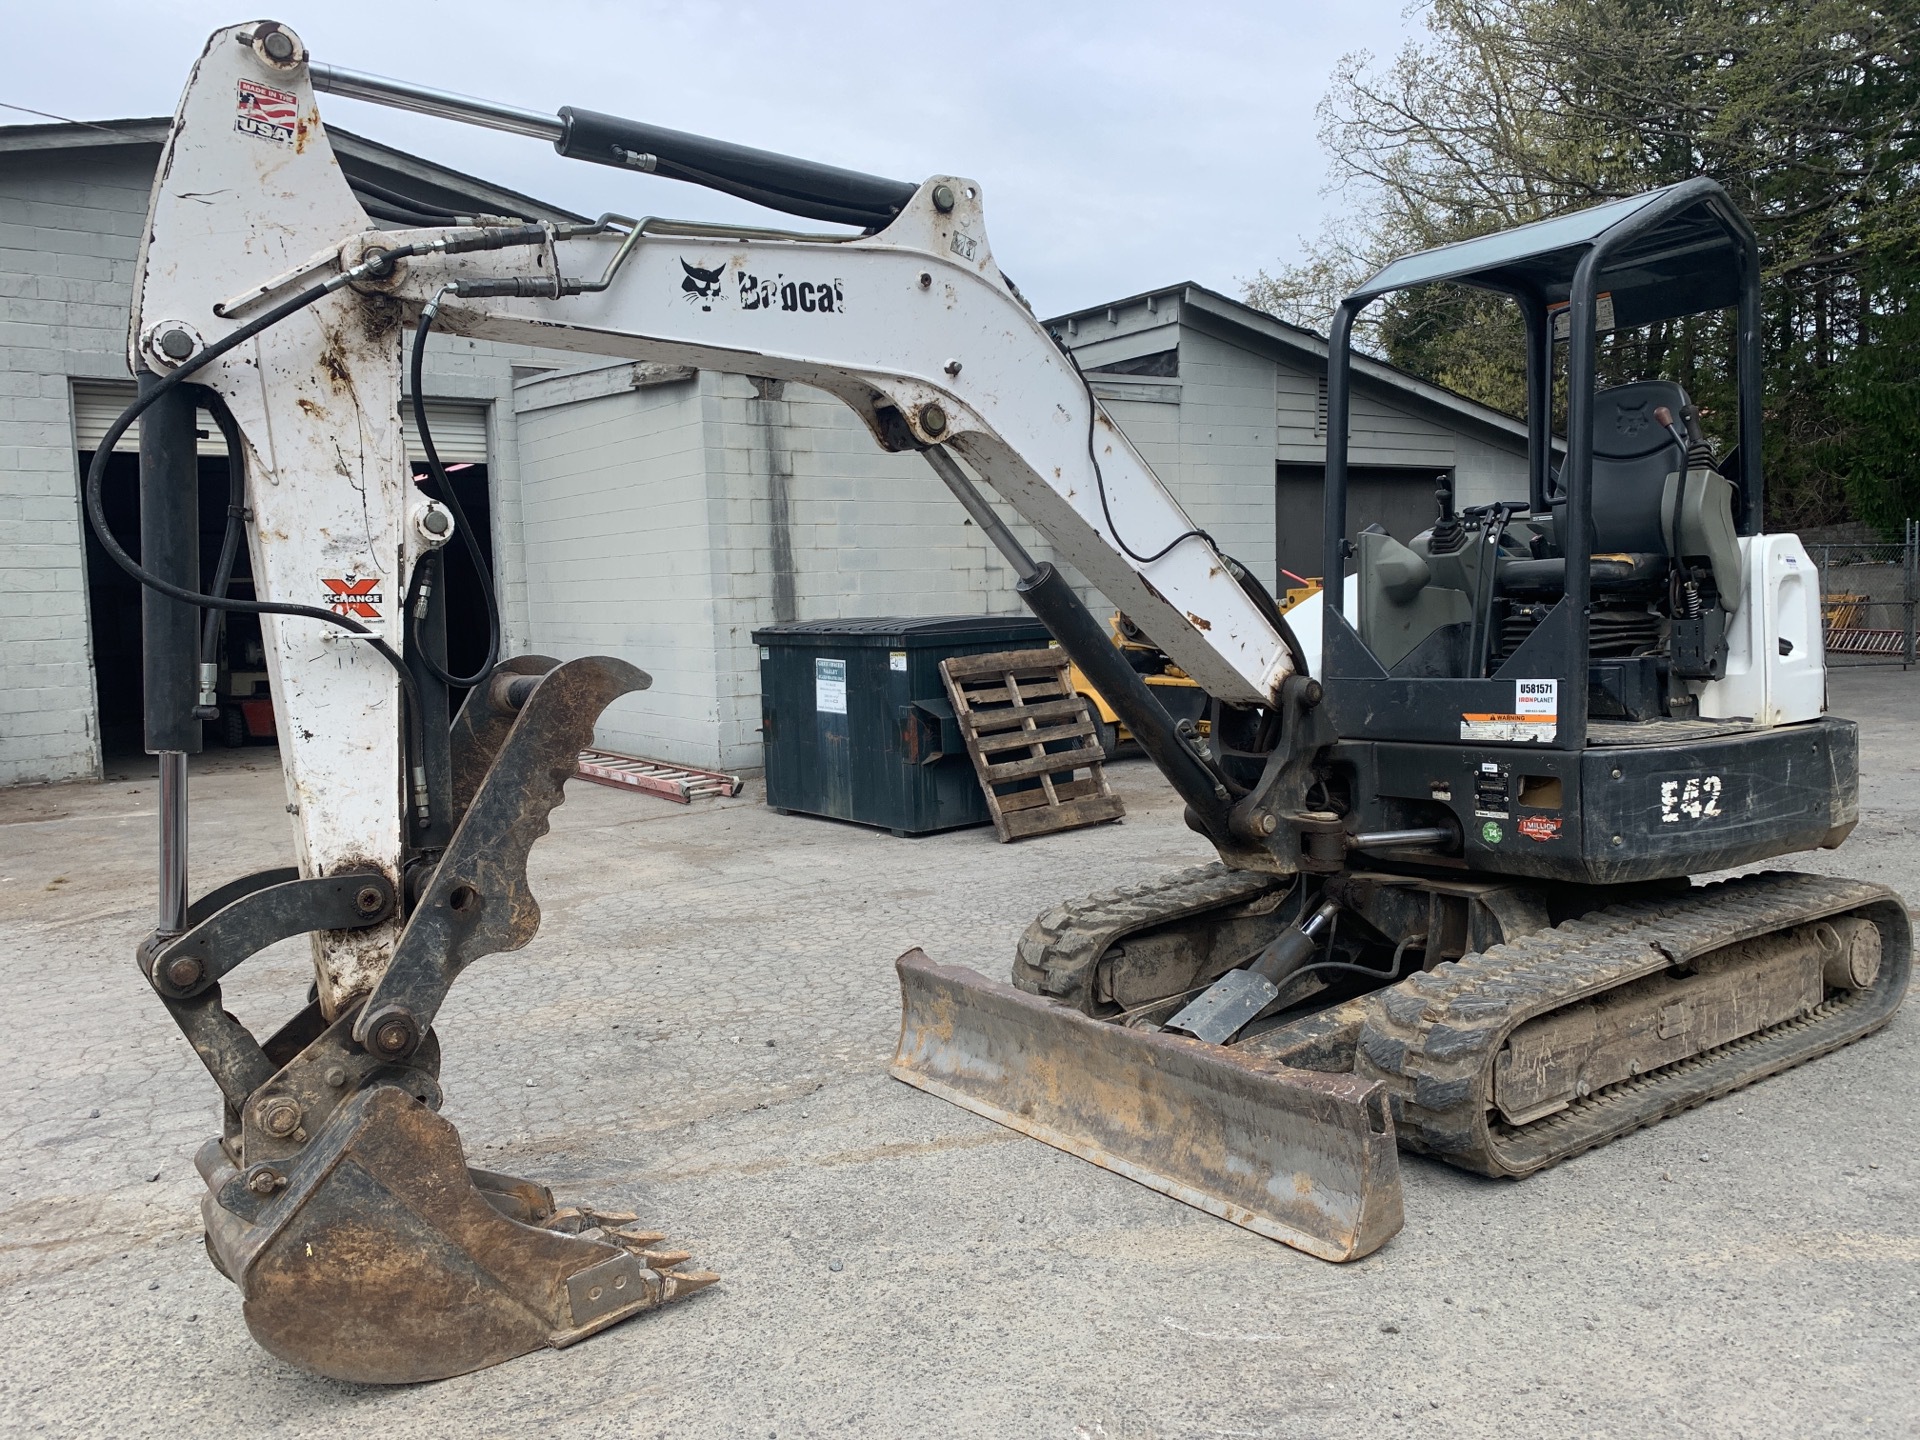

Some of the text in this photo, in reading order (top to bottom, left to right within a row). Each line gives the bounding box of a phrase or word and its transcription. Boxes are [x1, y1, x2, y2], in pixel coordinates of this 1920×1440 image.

[242, 83, 266, 95] MADE
[279, 94, 294, 103] THE
[239, 119, 292, 141] USA
[1520, 683, 1553, 694] U581571
[1661, 775, 1722, 822] E42
